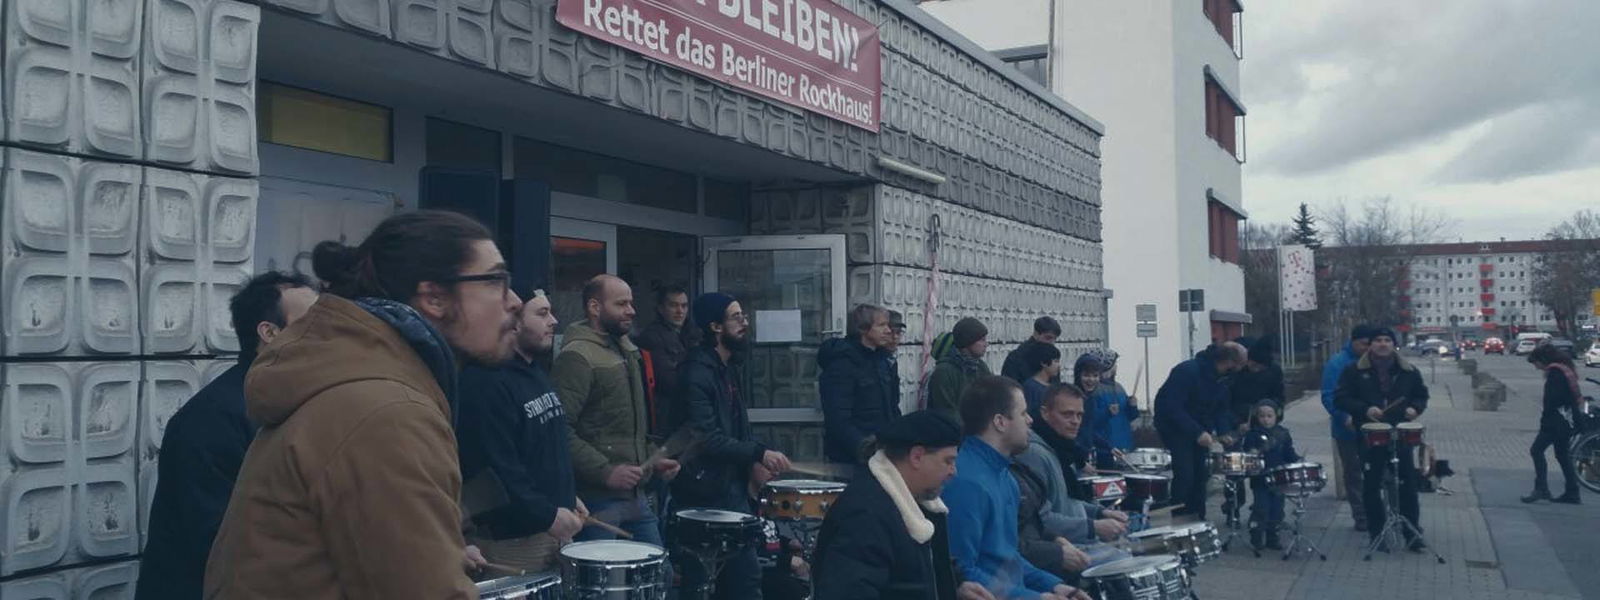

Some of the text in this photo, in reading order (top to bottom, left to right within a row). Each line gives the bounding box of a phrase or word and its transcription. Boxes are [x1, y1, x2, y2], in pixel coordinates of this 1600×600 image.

[584, 0, 873, 125] Rettet das Berliner Rockhaus!
